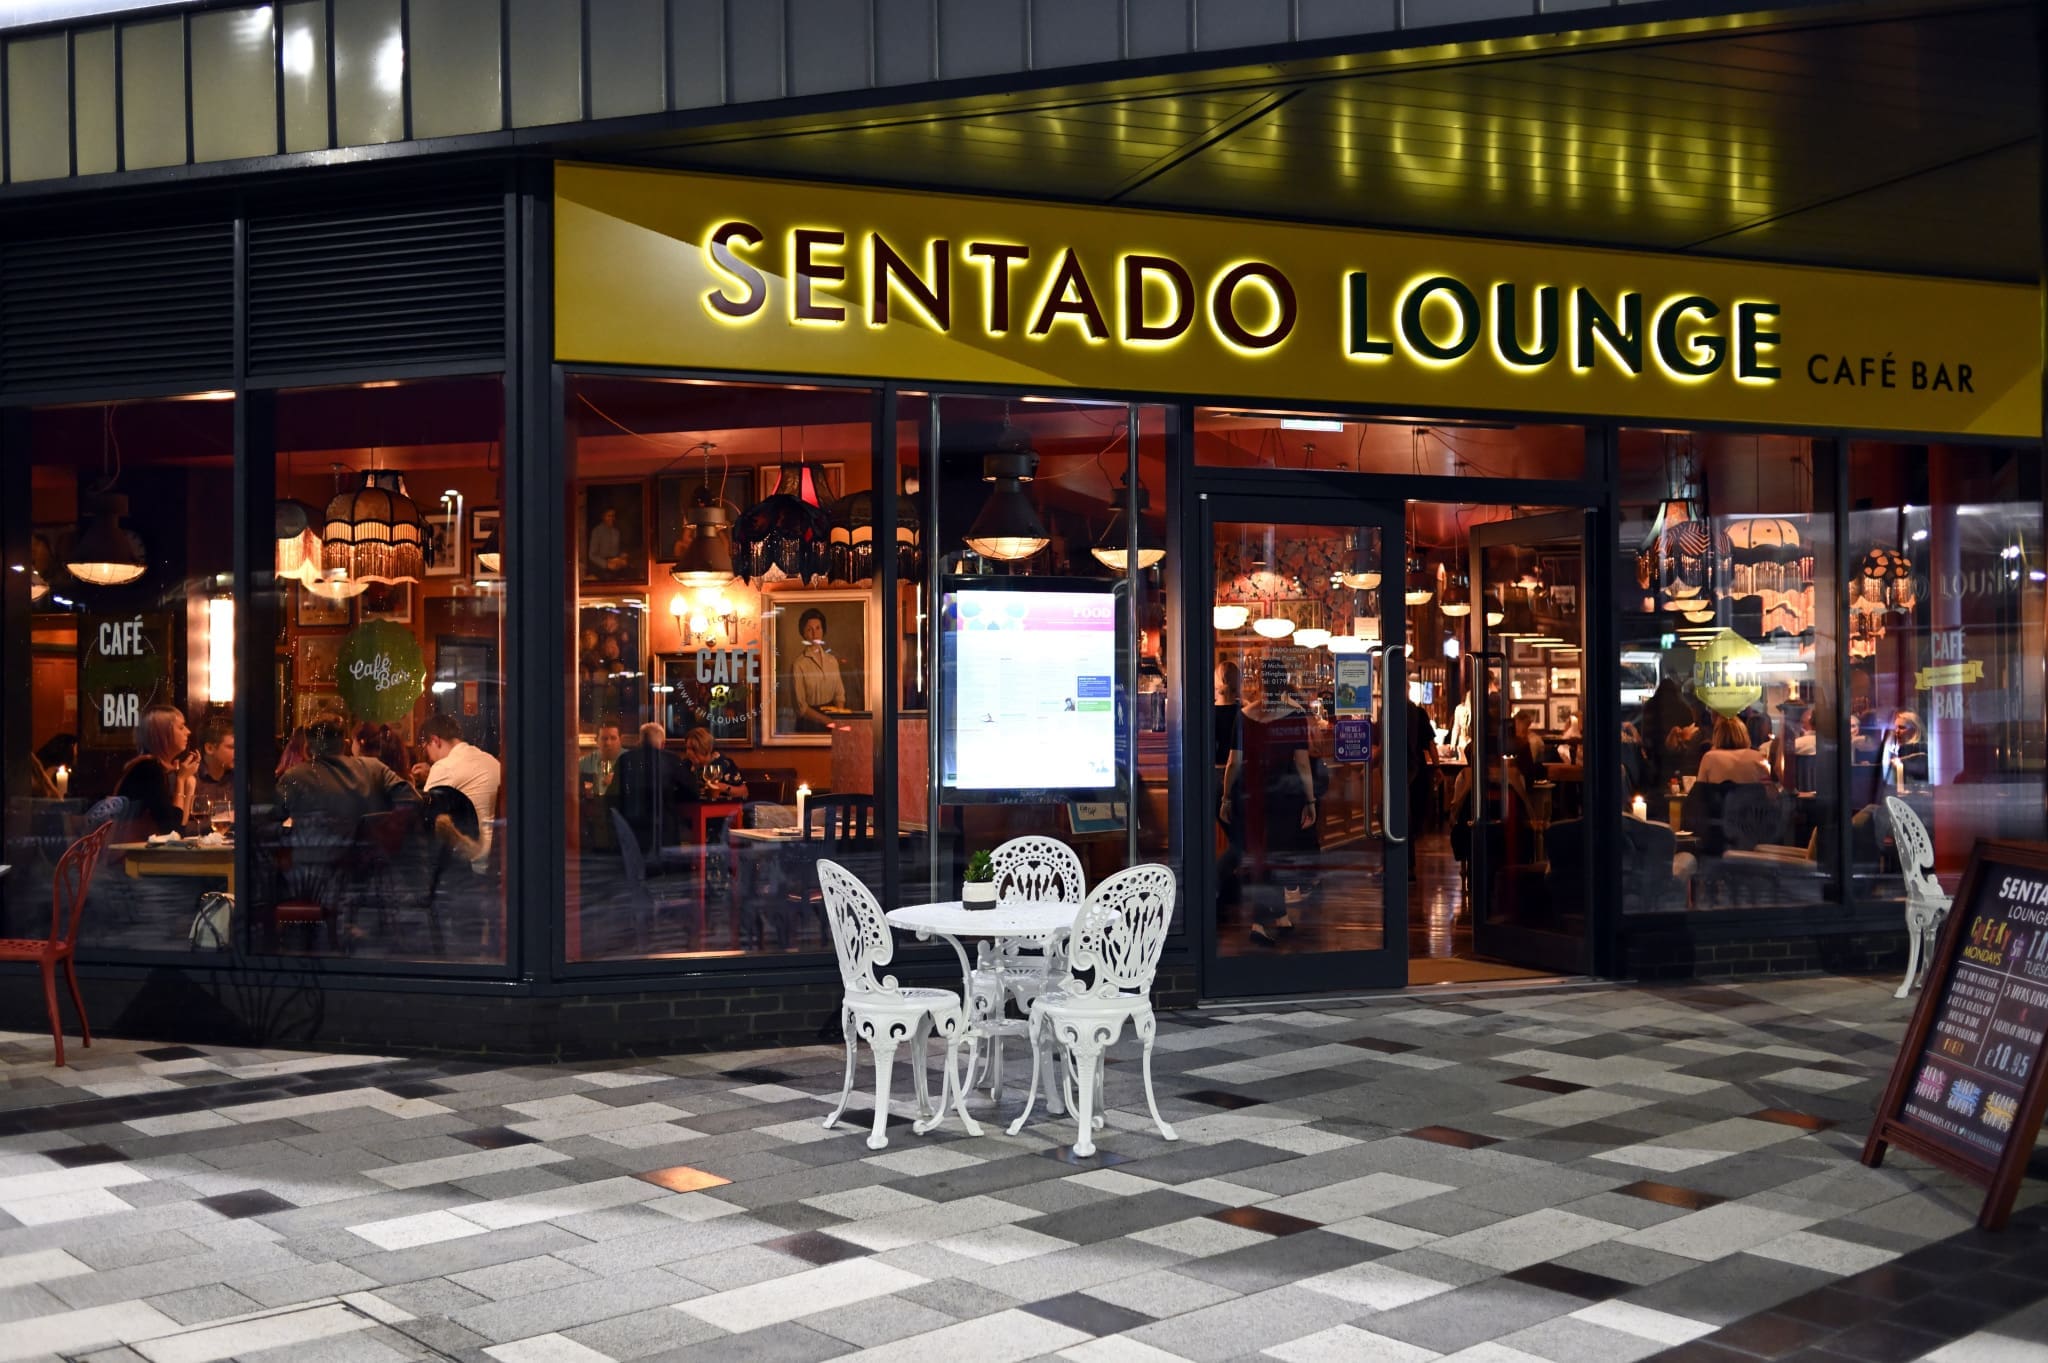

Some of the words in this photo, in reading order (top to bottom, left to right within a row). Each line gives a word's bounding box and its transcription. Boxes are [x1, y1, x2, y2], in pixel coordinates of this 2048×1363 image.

[704, 217, 1300, 353] SENTADO
[1345, 270, 1783, 385] LOUNGE
[1807, 352, 1896, 388] CAFÉ
[1912, 361, 1974, 393] BAR
[1072, 606, 1113, 619] FOOD
[99, 614, 144, 656] CAFÉ
[1931, 626, 1967, 660] CAFÉ
[350, 652, 391, 680] Café
[696, 639, 760, 684] CAFÉ
[1693, 655, 1731, 688] CAFÉ
[375, 668, 411, 692] Bar
[103, 693, 140, 727] BAR
[1935, 691, 1965, 720] BAR
[1963, 945, 2003, 966] MONDAYS
